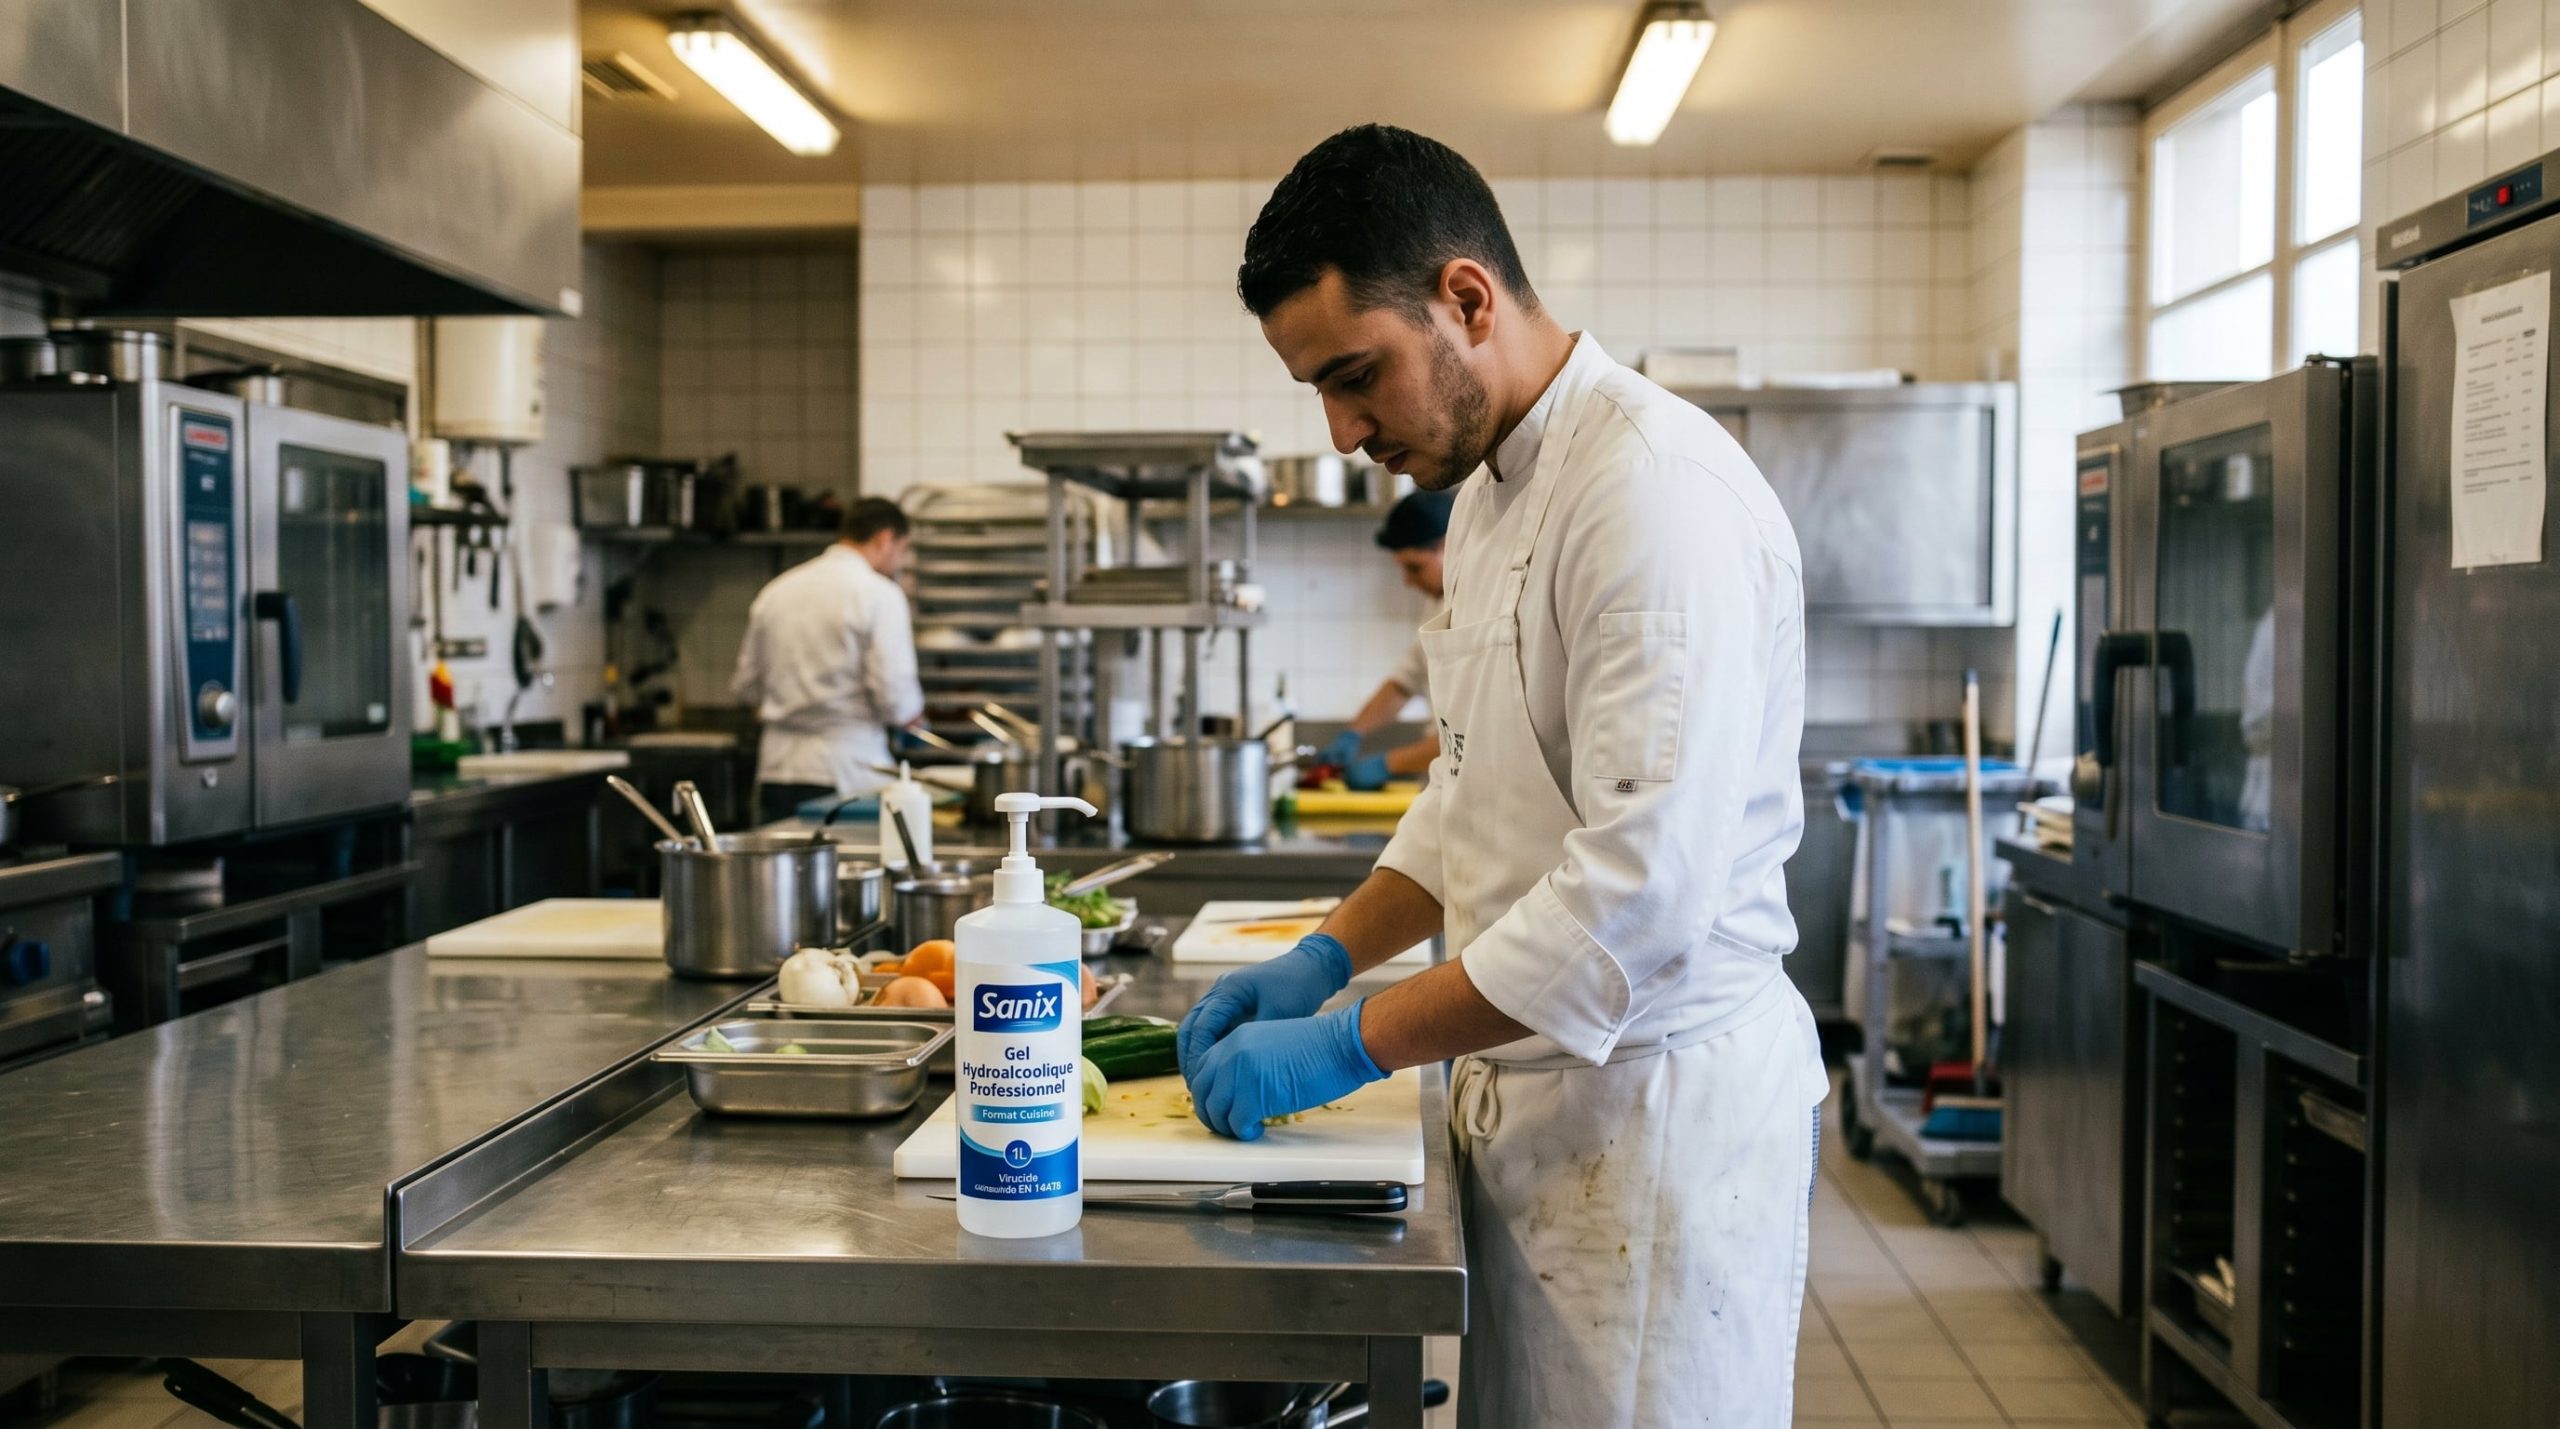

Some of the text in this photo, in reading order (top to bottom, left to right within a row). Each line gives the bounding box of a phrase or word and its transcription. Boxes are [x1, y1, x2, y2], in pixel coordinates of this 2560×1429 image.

[979, 990, 1058, 1019] Sanix
[1004, 1046, 1030, 1061] Gel
[963, 1061, 1074, 1080] Hydroalcoolique
[970, 1079, 1065, 1097] Professionnel
[982, 1109, 1055, 1120] Format Cuisine
[1011, 1147, 1027, 1160] 1L
[998, 1173, 1039, 1183] Virucide
[1018, 1184, 1032, 1194] EN
